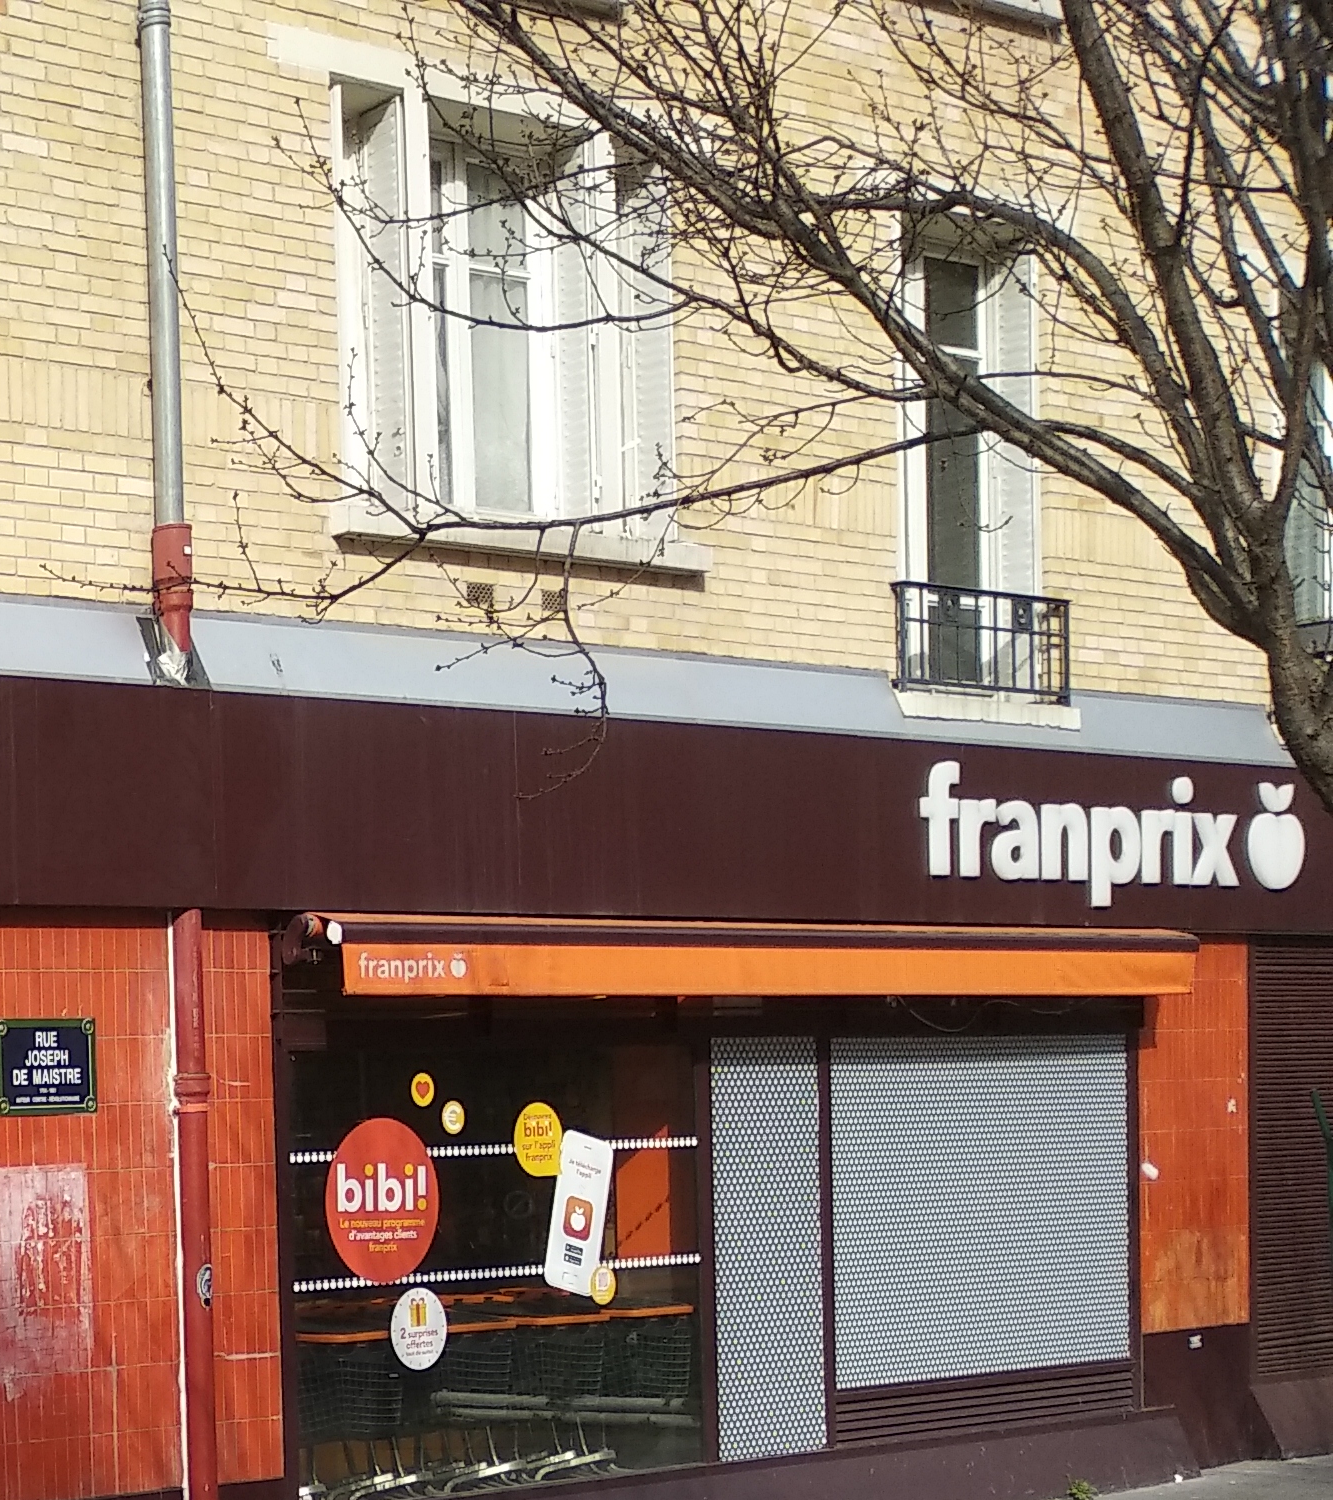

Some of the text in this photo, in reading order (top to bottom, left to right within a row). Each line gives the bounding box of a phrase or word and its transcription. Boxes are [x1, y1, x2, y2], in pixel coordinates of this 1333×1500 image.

[919, 760, 1240, 907] franprix
[358, 951, 446, 984] franprix
[35, 1031, 58, 1047] RUE
[25, 1050, 69, 1066] JOSEPH
[13, 1068, 81, 1085] DE MAISTRE
[524, 1121, 553, 1137] bibi!
[337, 1163, 427, 1213] bibi!
[339, 1218, 426, 1229] Le nouveau programme
[349, 1229, 417, 1242] d'avantages clients
[368, 1243, 398, 1253] franprix
[400, 1327, 439, 1340] 2 surprises
[406, 1340, 434, 1349] offertes
